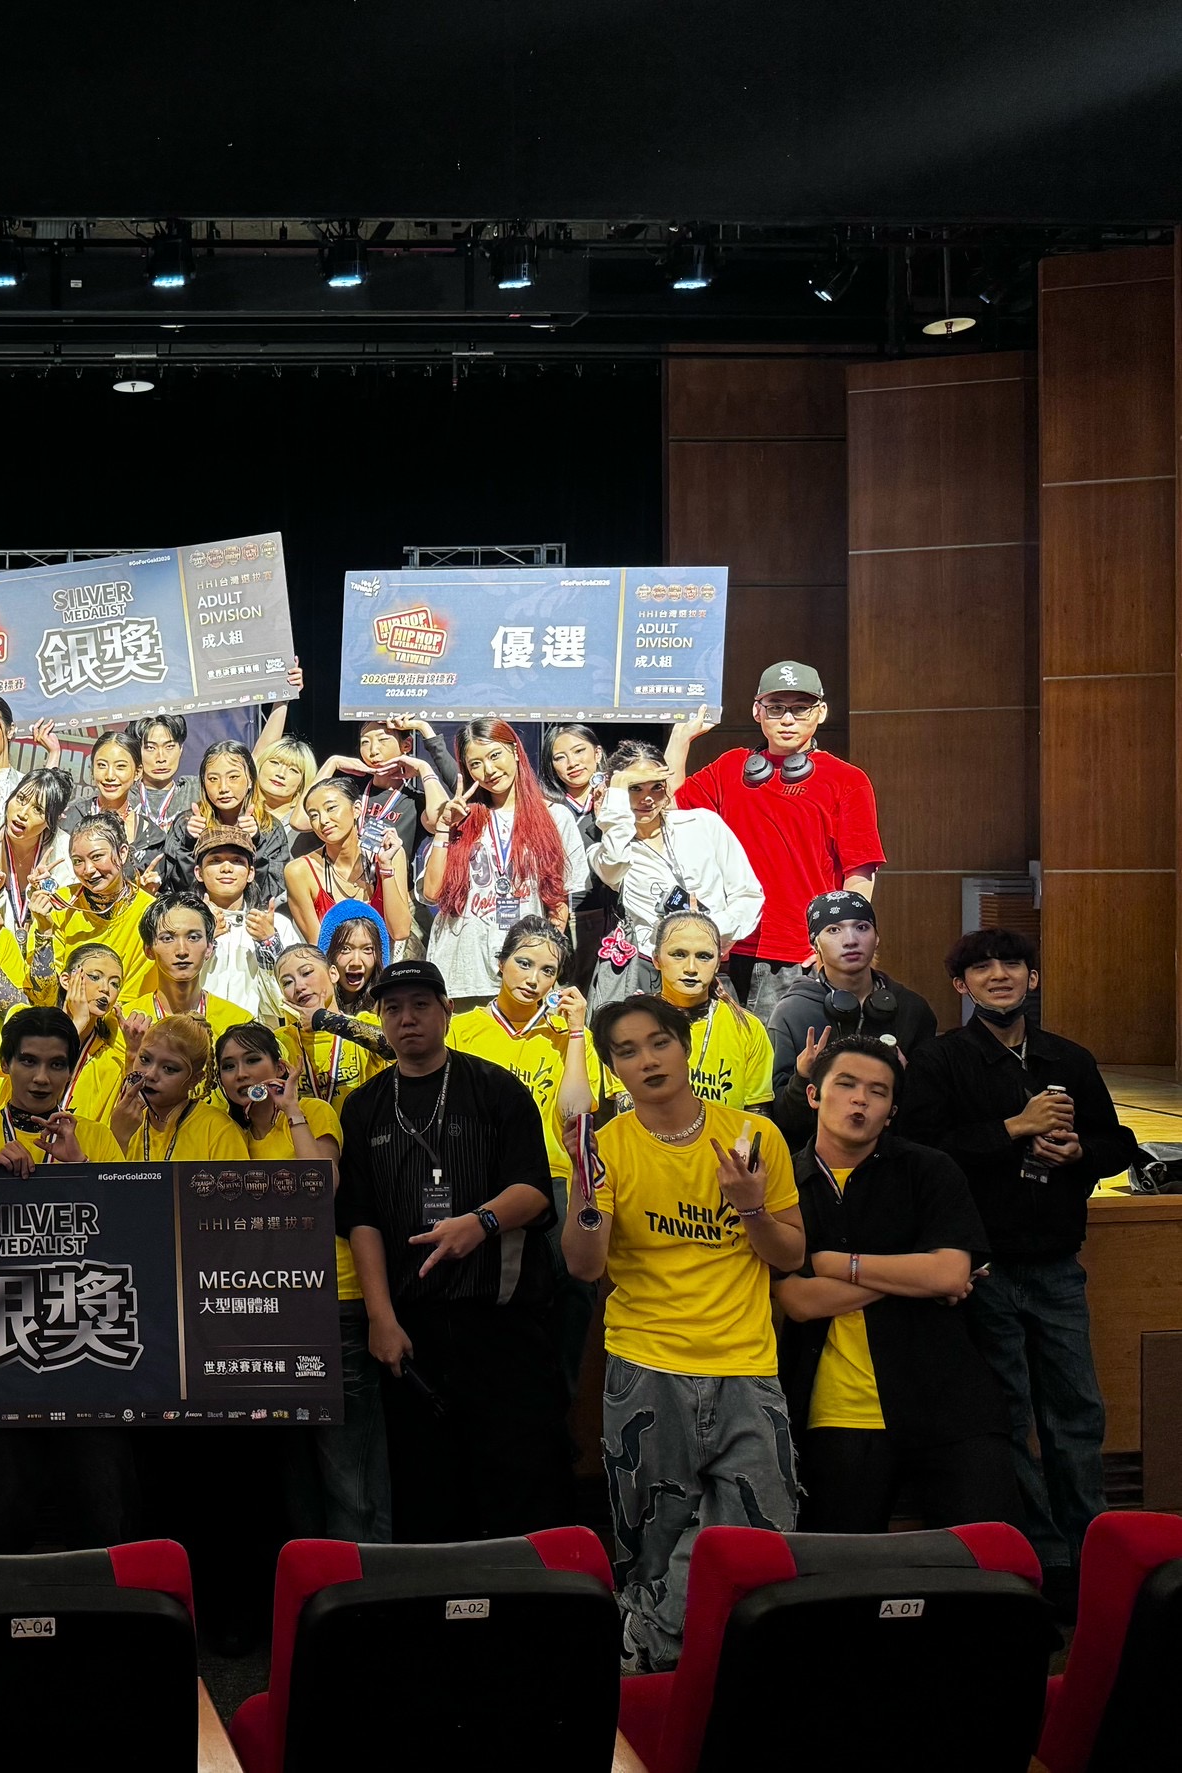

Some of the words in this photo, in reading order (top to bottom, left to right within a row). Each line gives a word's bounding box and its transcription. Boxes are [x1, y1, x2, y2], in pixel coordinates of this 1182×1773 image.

[53, 581, 134, 612] SILVER
[198, 591, 242, 610] ADULT
[63, 603, 126, 623] MEDALIST
[200, 605, 262, 626] DIVISION
[636, 623, 678, 634] ADULT
[202, 630, 244, 649] 成人組
[394, 628, 416, 642] HIP
[416, 631, 442, 646] HOP
[636, 637, 692, 648] DIVISION
[392, 640, 439, 652] INTERNATIONAL
[490, 624, 586, 670] 優選
[39, 620, 164, 695] 銀獎
[396, 652, 432, 666] TAIWAN
[634, 656, 672, 668] 成人組
[782, 786, 807, 796] HUF
[98, 1173, 162, 1181] #GoForGold2026
[246, 1182, 267, 1192] DROP
[678, 1202, 713, 1224] HHI
[645, 1211, 721, 1240] TAIWAN
[199, 1270, 324, 1289] MEGACREW
[199, 1298, 280, 1314] 大型團體組
[204, 1360, 286, 1374] 世界決賽資格權
[296, 1362, 310, 1370] HIP
[310, 1362, 325, 1370] HOP
[452, 1603, 484, 1614] A-02
[13, 1622, 53, 1634] A-04
